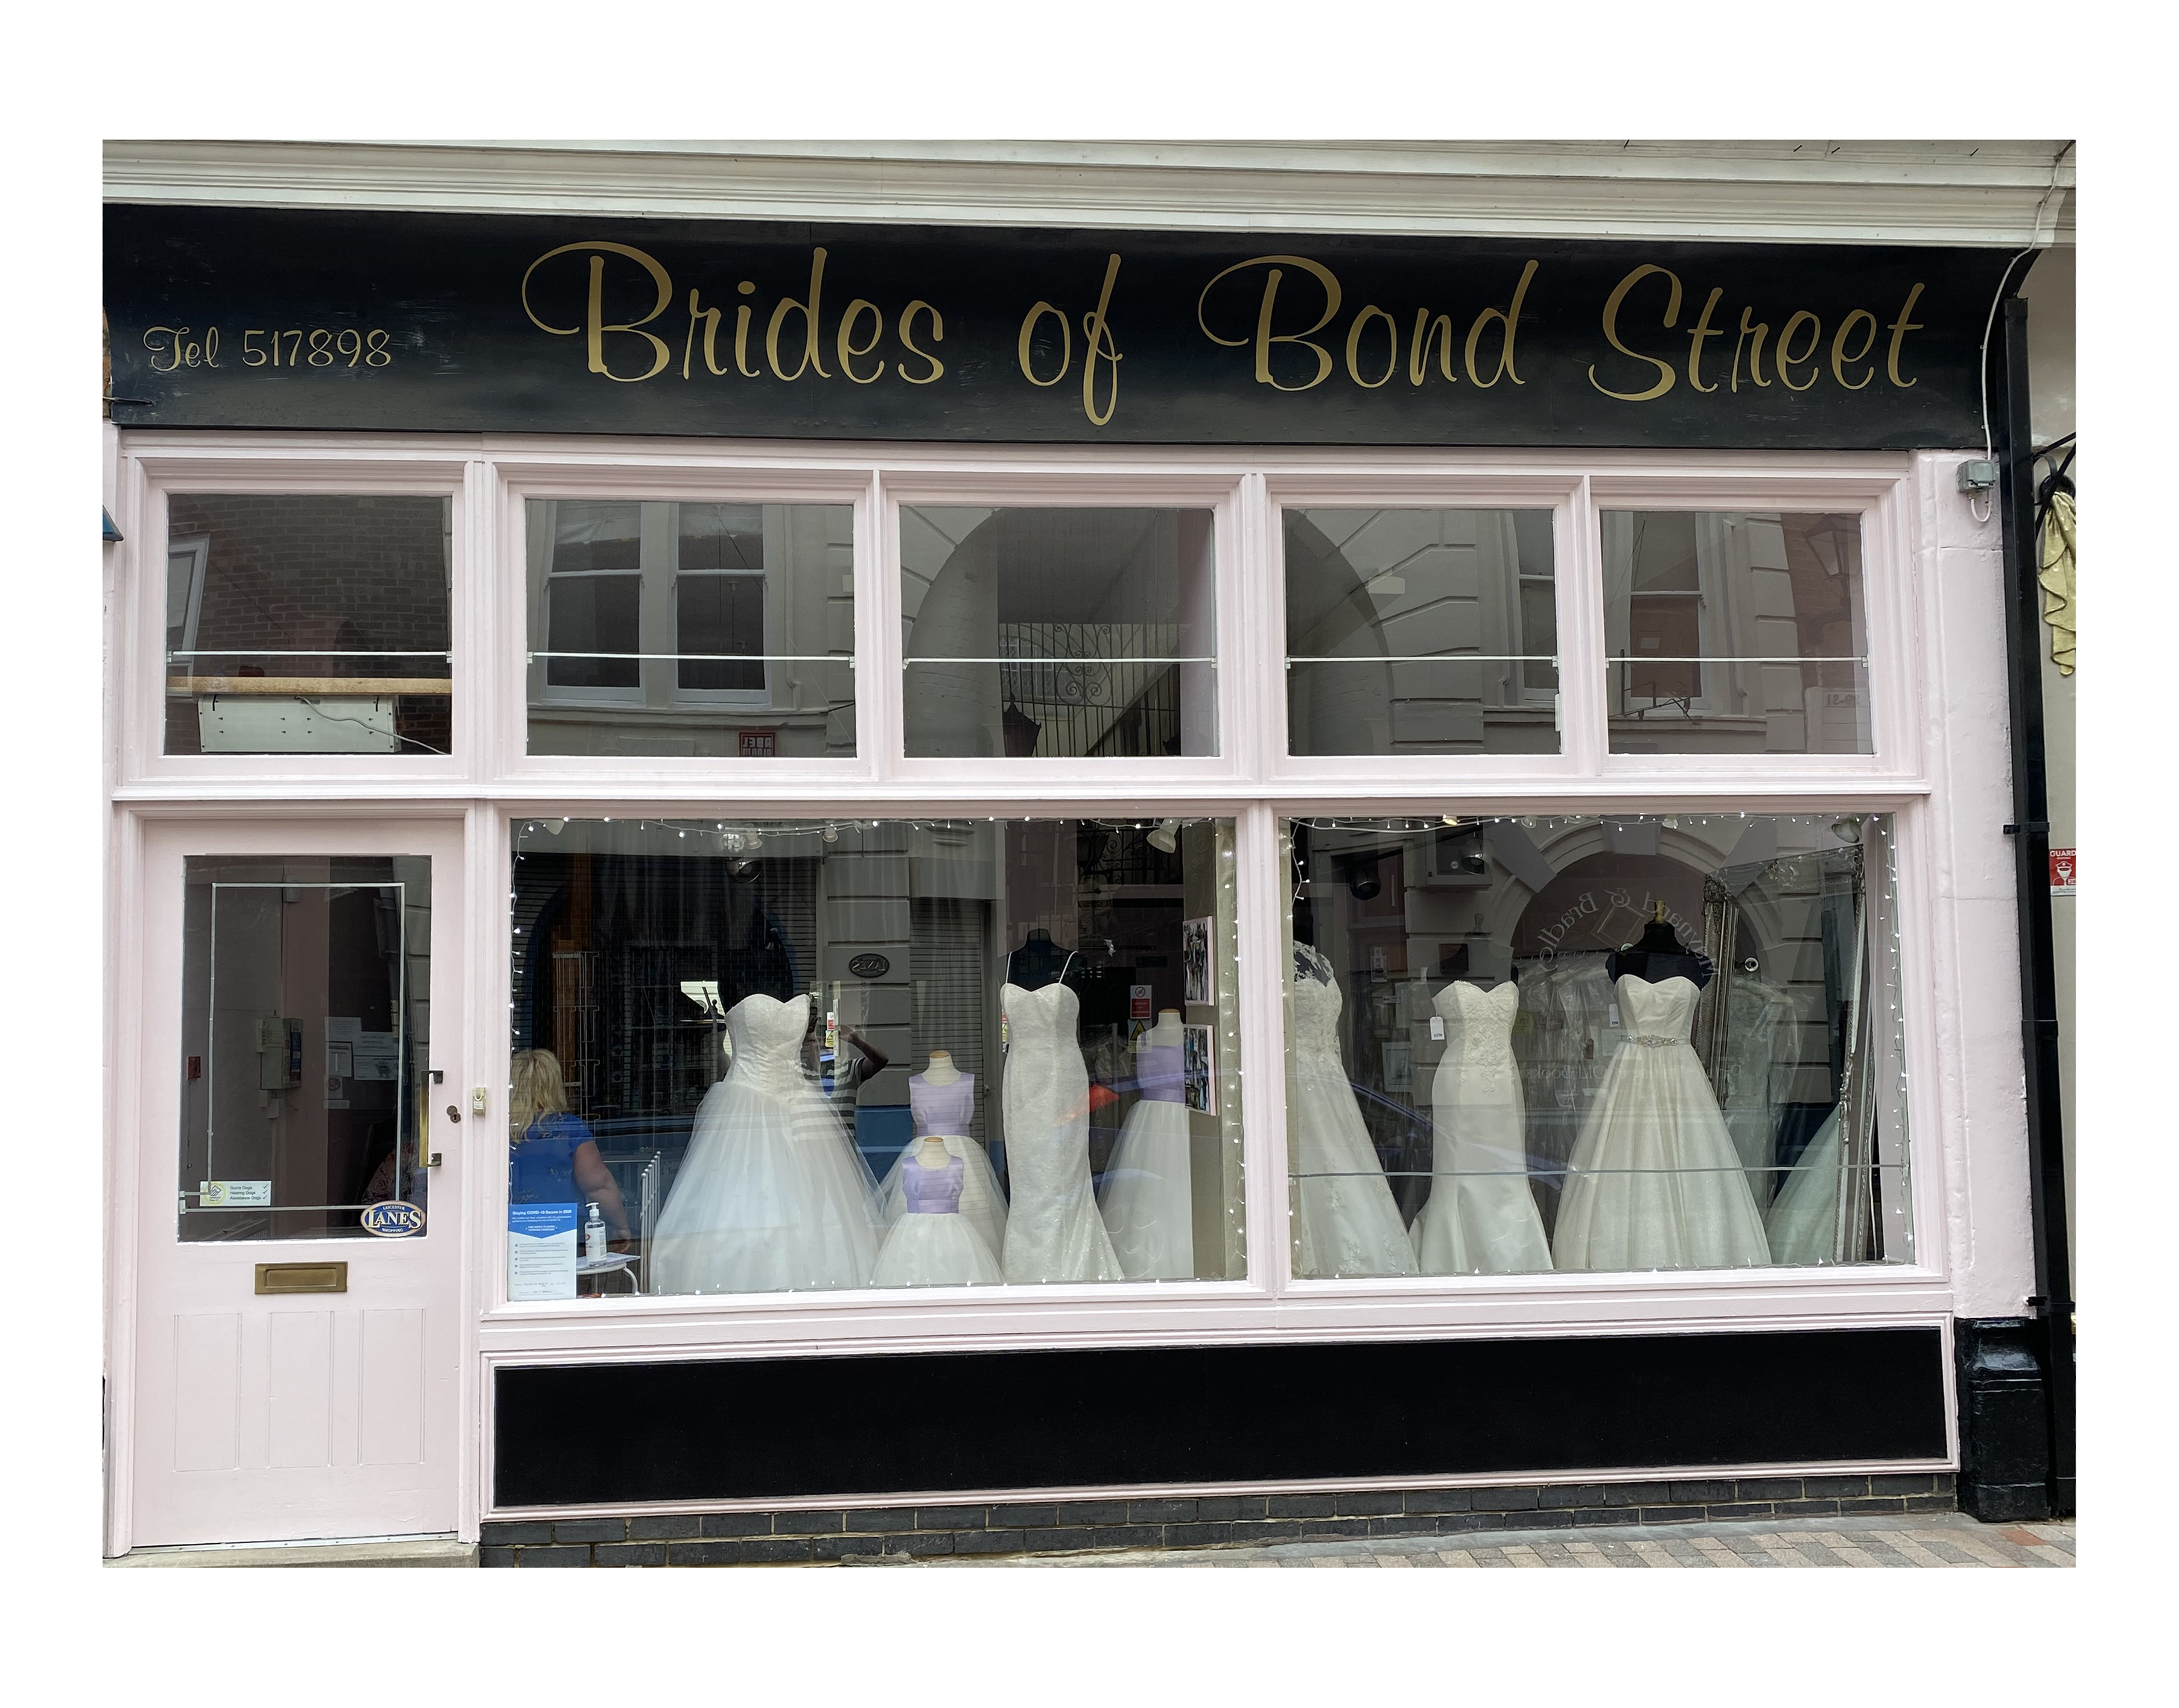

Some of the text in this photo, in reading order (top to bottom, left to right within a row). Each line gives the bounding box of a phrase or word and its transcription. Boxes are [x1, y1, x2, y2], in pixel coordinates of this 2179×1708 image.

[142, 325, 392, 372] Tel 517898
[522, 241, 1926, 426] Brides of Bond Street
[366, 1209, 422, 1229] LANES
